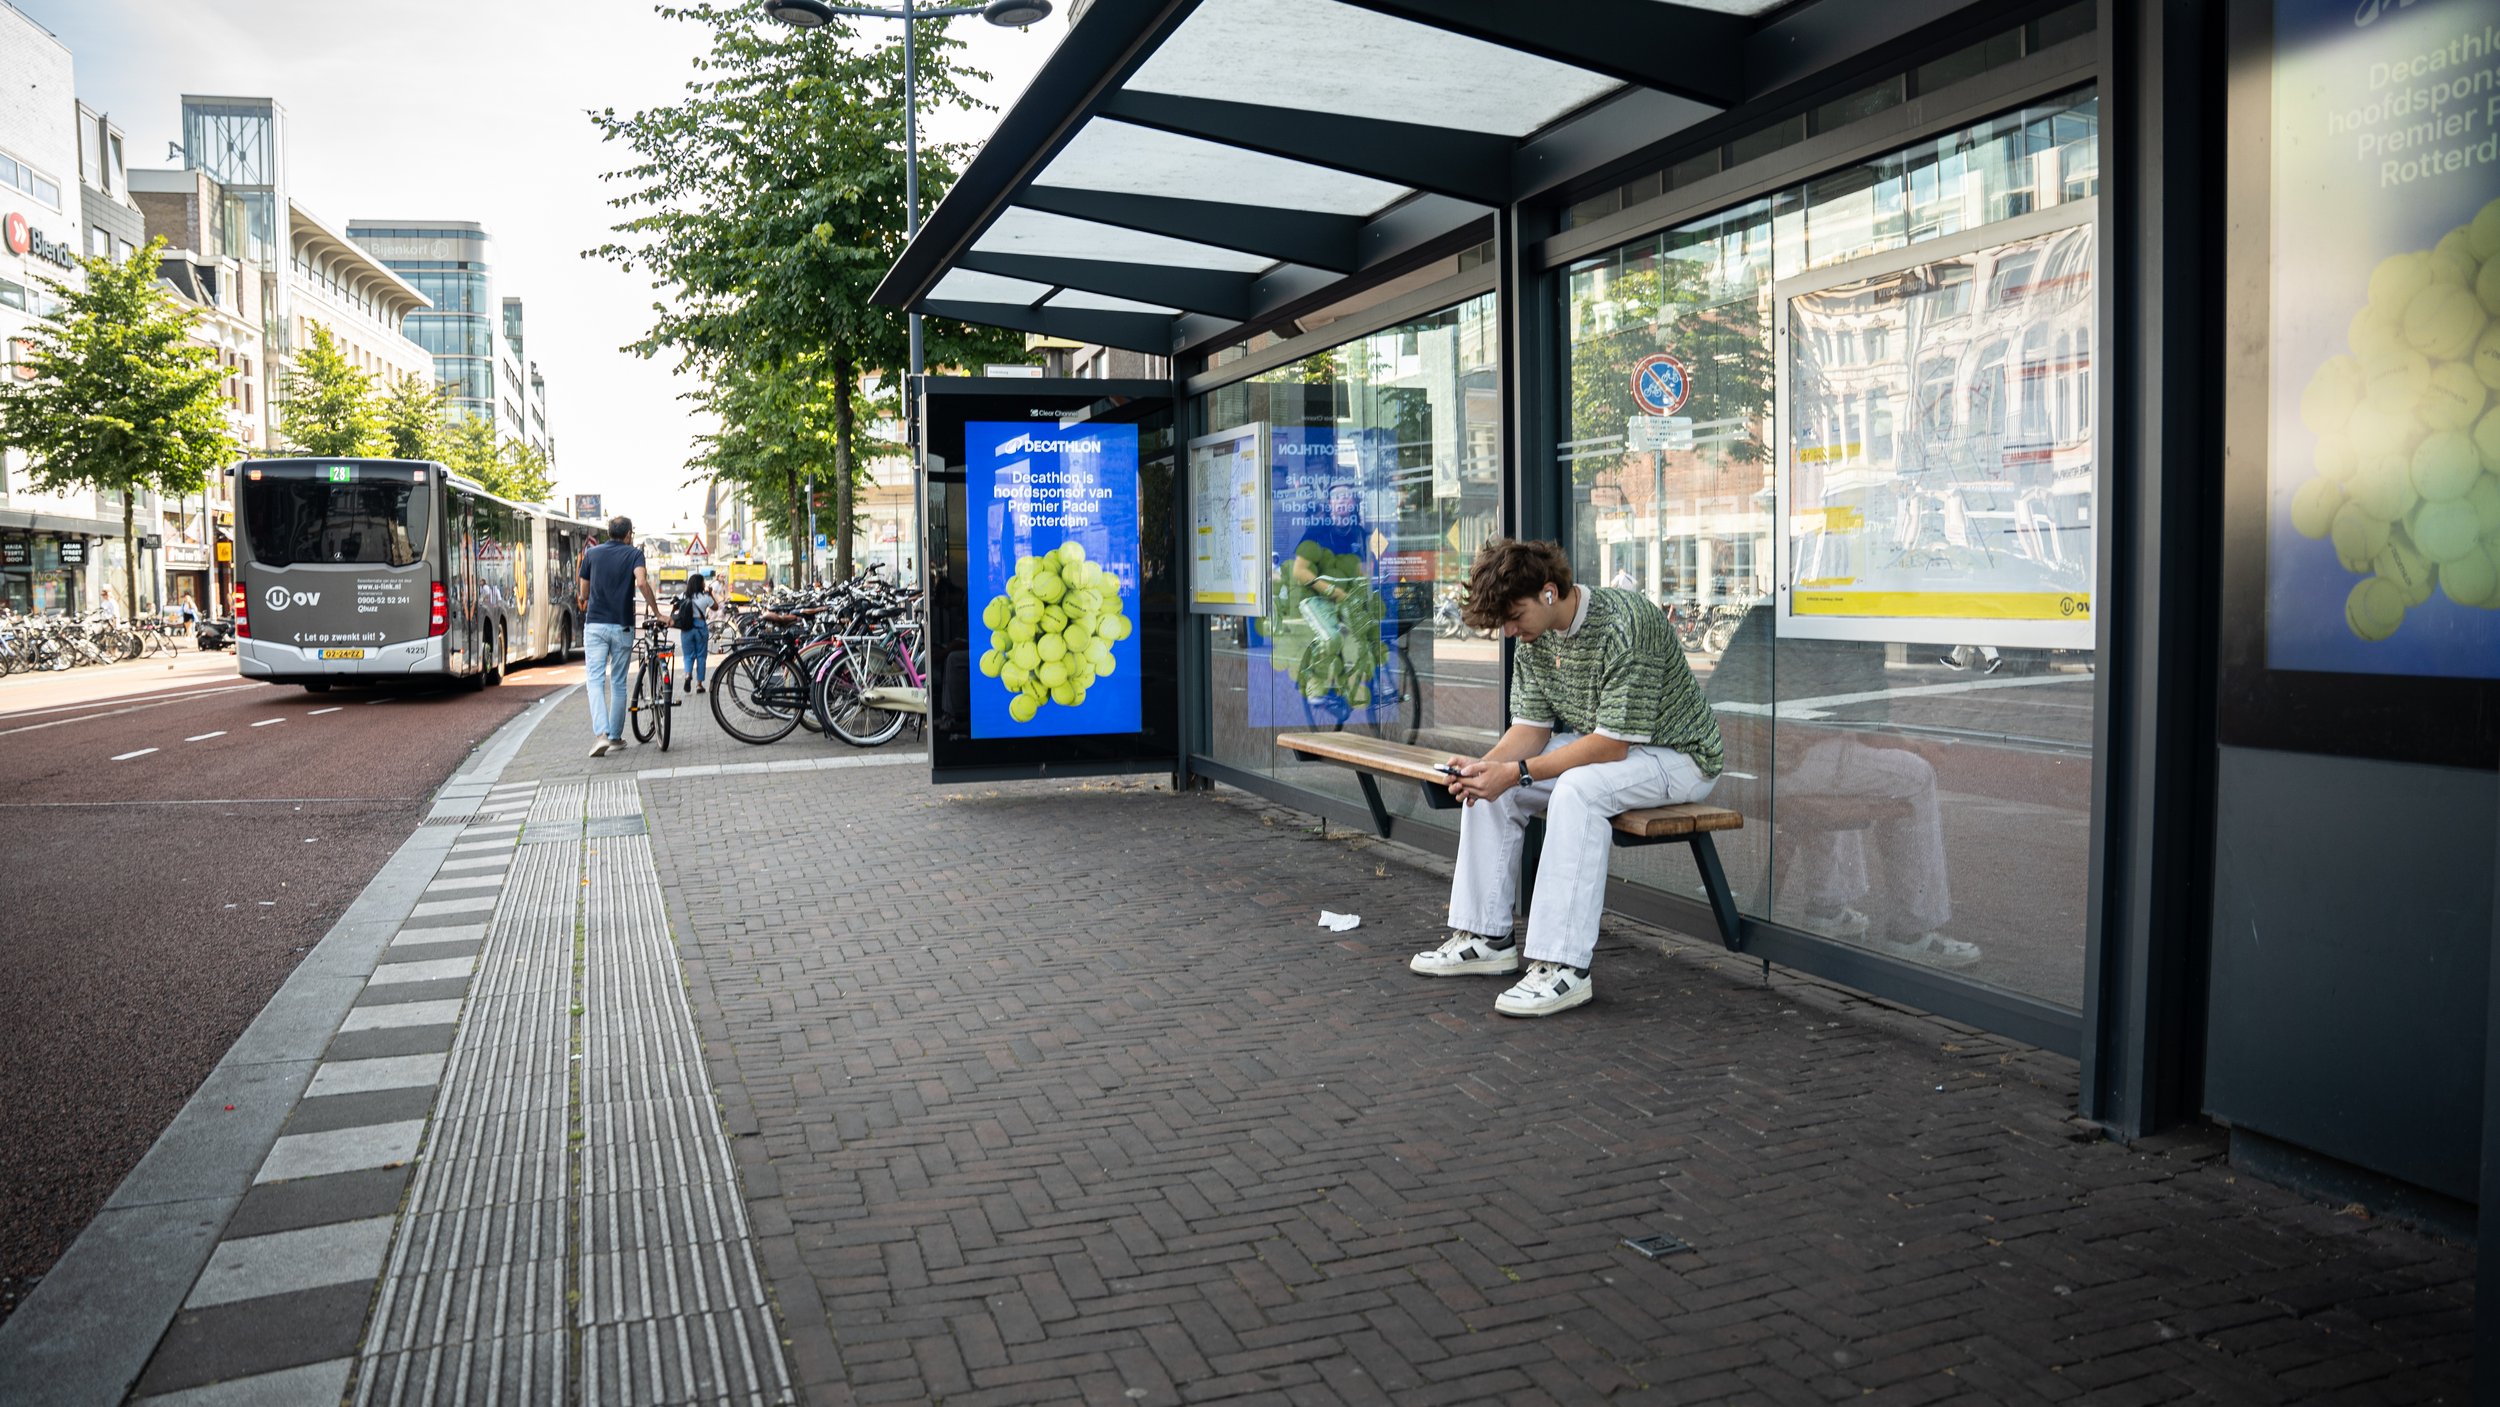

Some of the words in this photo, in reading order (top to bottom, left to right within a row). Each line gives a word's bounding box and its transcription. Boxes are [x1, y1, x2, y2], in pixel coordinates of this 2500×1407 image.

[2328, 67, 2500, 136] hoofdspon
[2358, 108, 2478, 161] Premier
[2380, 132, 2500, 188] Rotterd
[371, 243, 428, 256] Bijenkorf
[1024, 440, 1101, 453] DECATHLON
[333, 466, 346, 480] 28
[1012, 471, 1080, 484] Decathlon
[1083, 471, 1094, 484] is
[993, 485, 1086, 500] hoofdsponsor
[1089, 488, 1112, 498] van
[1008, 500, 1060, 512] Premier
[1062, 500, 1099, 512] Padel
[1019, 514, 1088, 527] Rotterdam
[817, 536, 824, 545] P
[293, 592, 320, 606] OV
[357, 596, 386, 604] 0900-52
[357, 605, 378, 613] Qbuzz
[304, 633, 318, 641] Let
[319, 635, 329, 643] op
[331, 633, 360, 641] zwenkt
[362, 632, 376, 641] uit!
